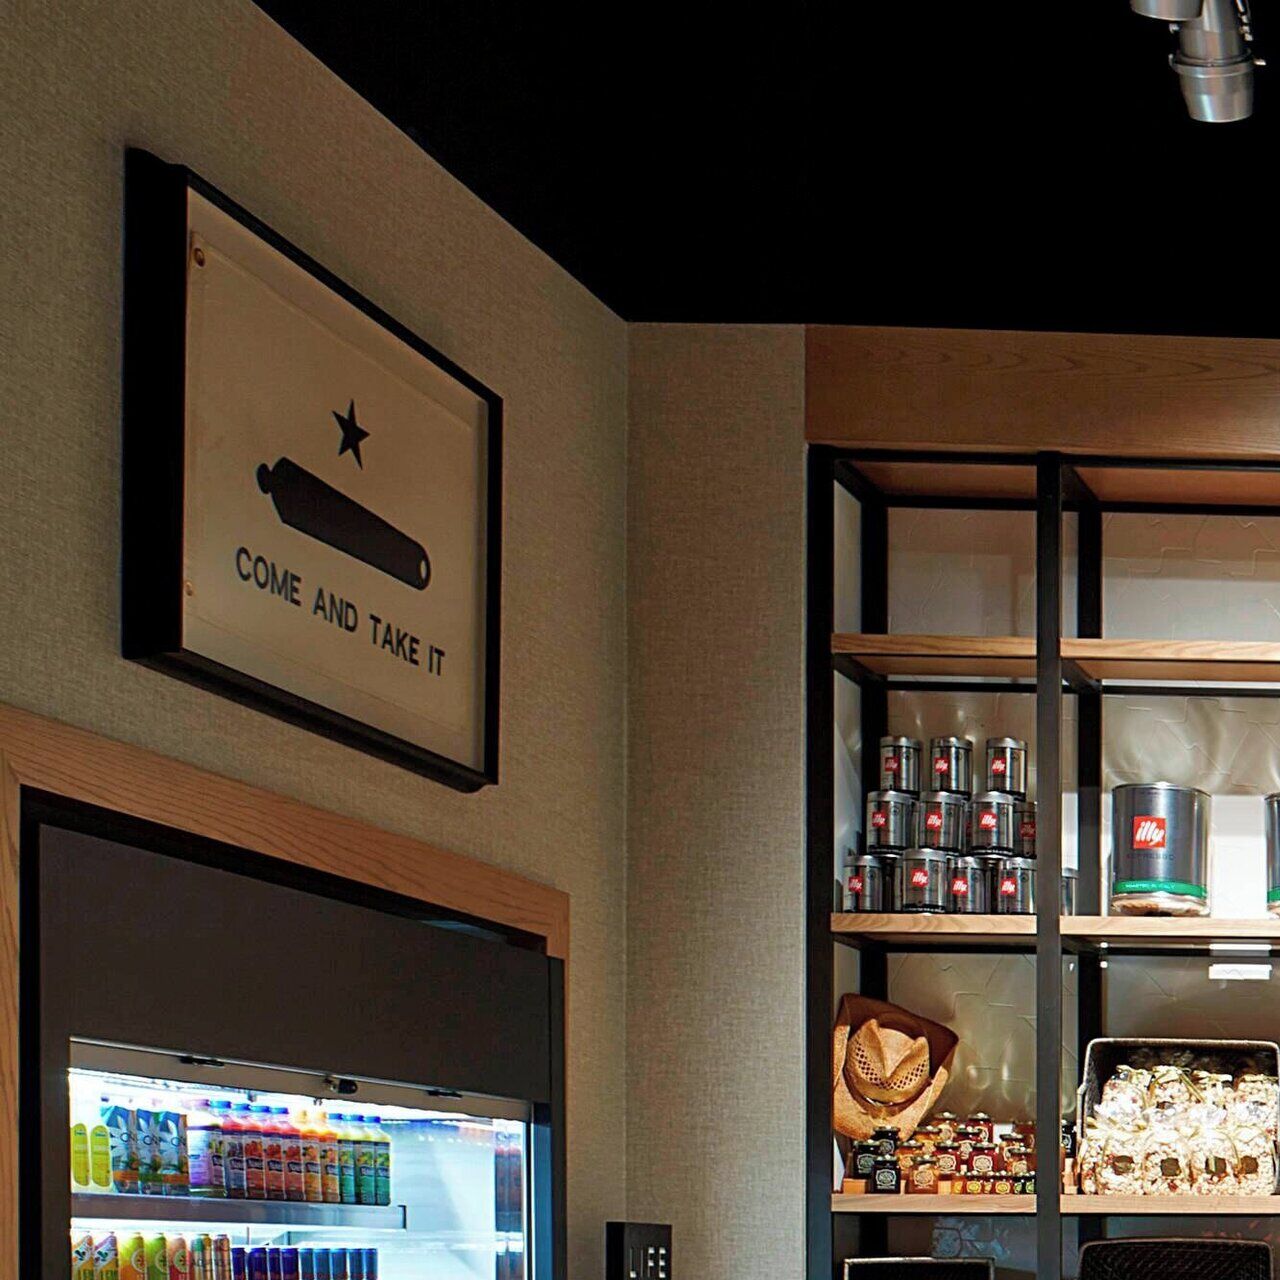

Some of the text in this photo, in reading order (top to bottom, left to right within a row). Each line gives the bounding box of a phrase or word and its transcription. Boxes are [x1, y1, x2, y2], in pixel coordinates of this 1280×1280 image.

[235, 546, 446, 677] COME AND TAKE IT
[1135, 820, 1166, 846] illy
[629, 1246, 666, 1278] LIFE
